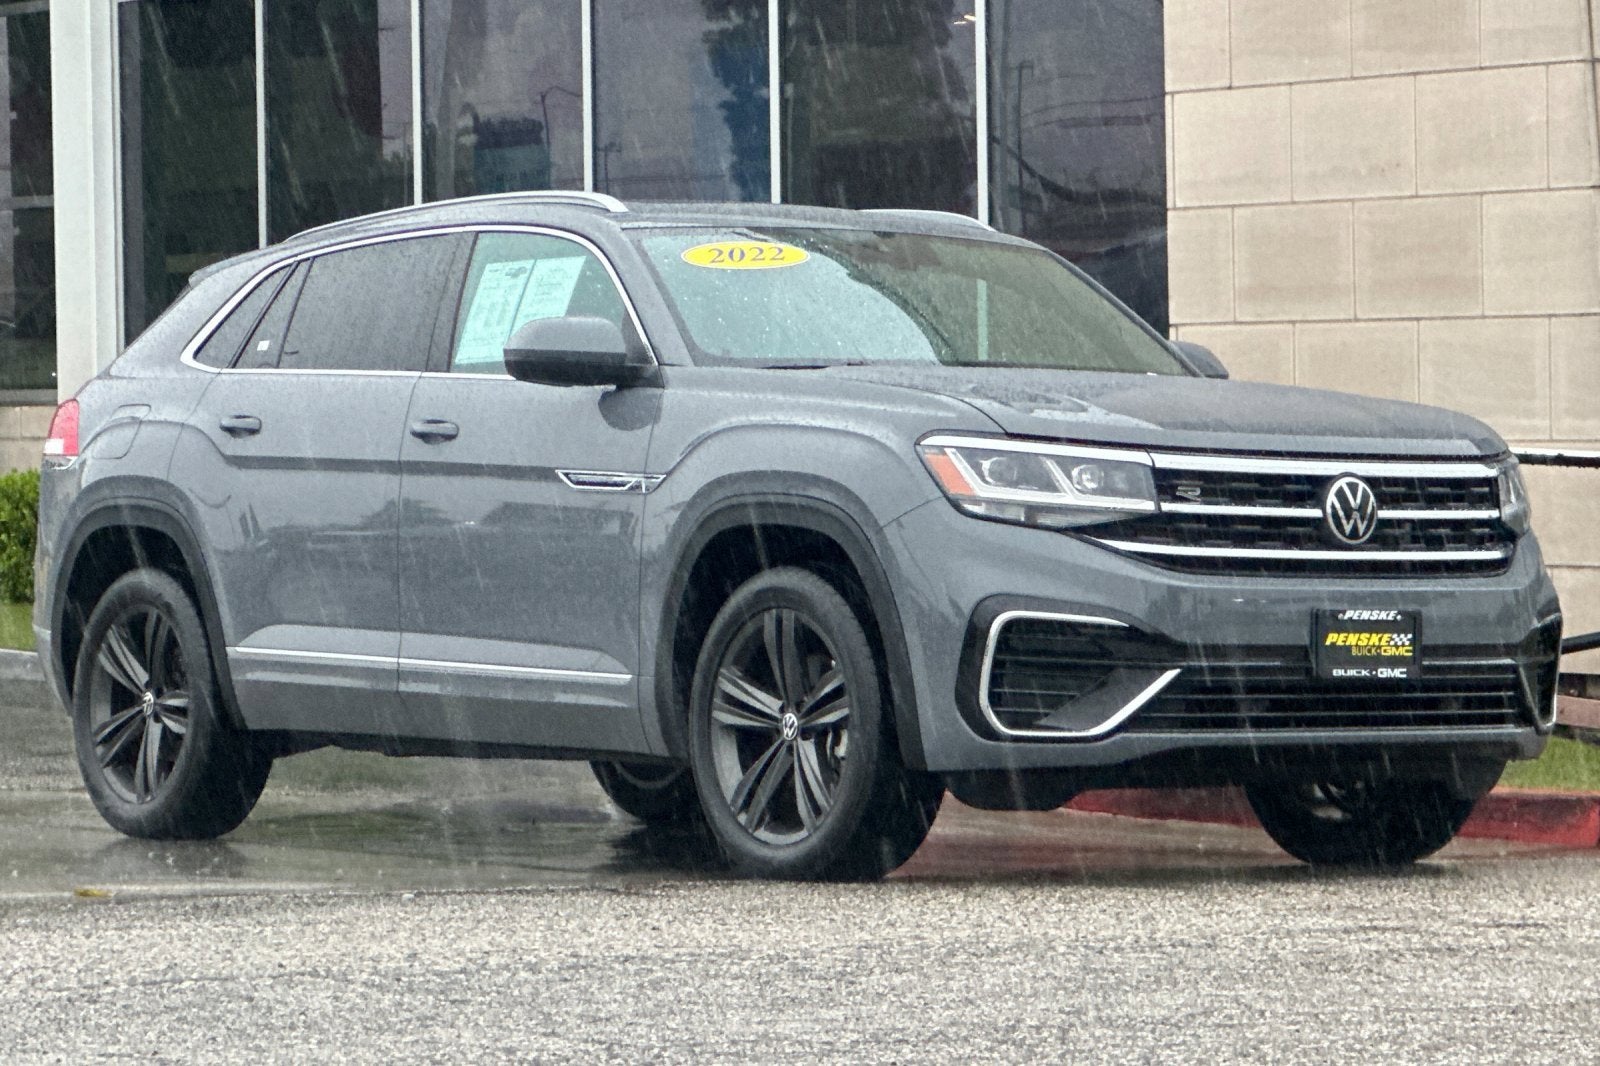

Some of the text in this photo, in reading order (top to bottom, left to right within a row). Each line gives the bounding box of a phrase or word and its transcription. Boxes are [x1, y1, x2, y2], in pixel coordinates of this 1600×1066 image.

[708, 246, 785, 264] 2022
[1344, 610, 1397, 620] PENSKE
[1325, 632, 1393, 646] PENSKE
[1351, 646, 1413, 656] BUICK GMC
[1332, 668, 1407, 678] BUICK GMC
